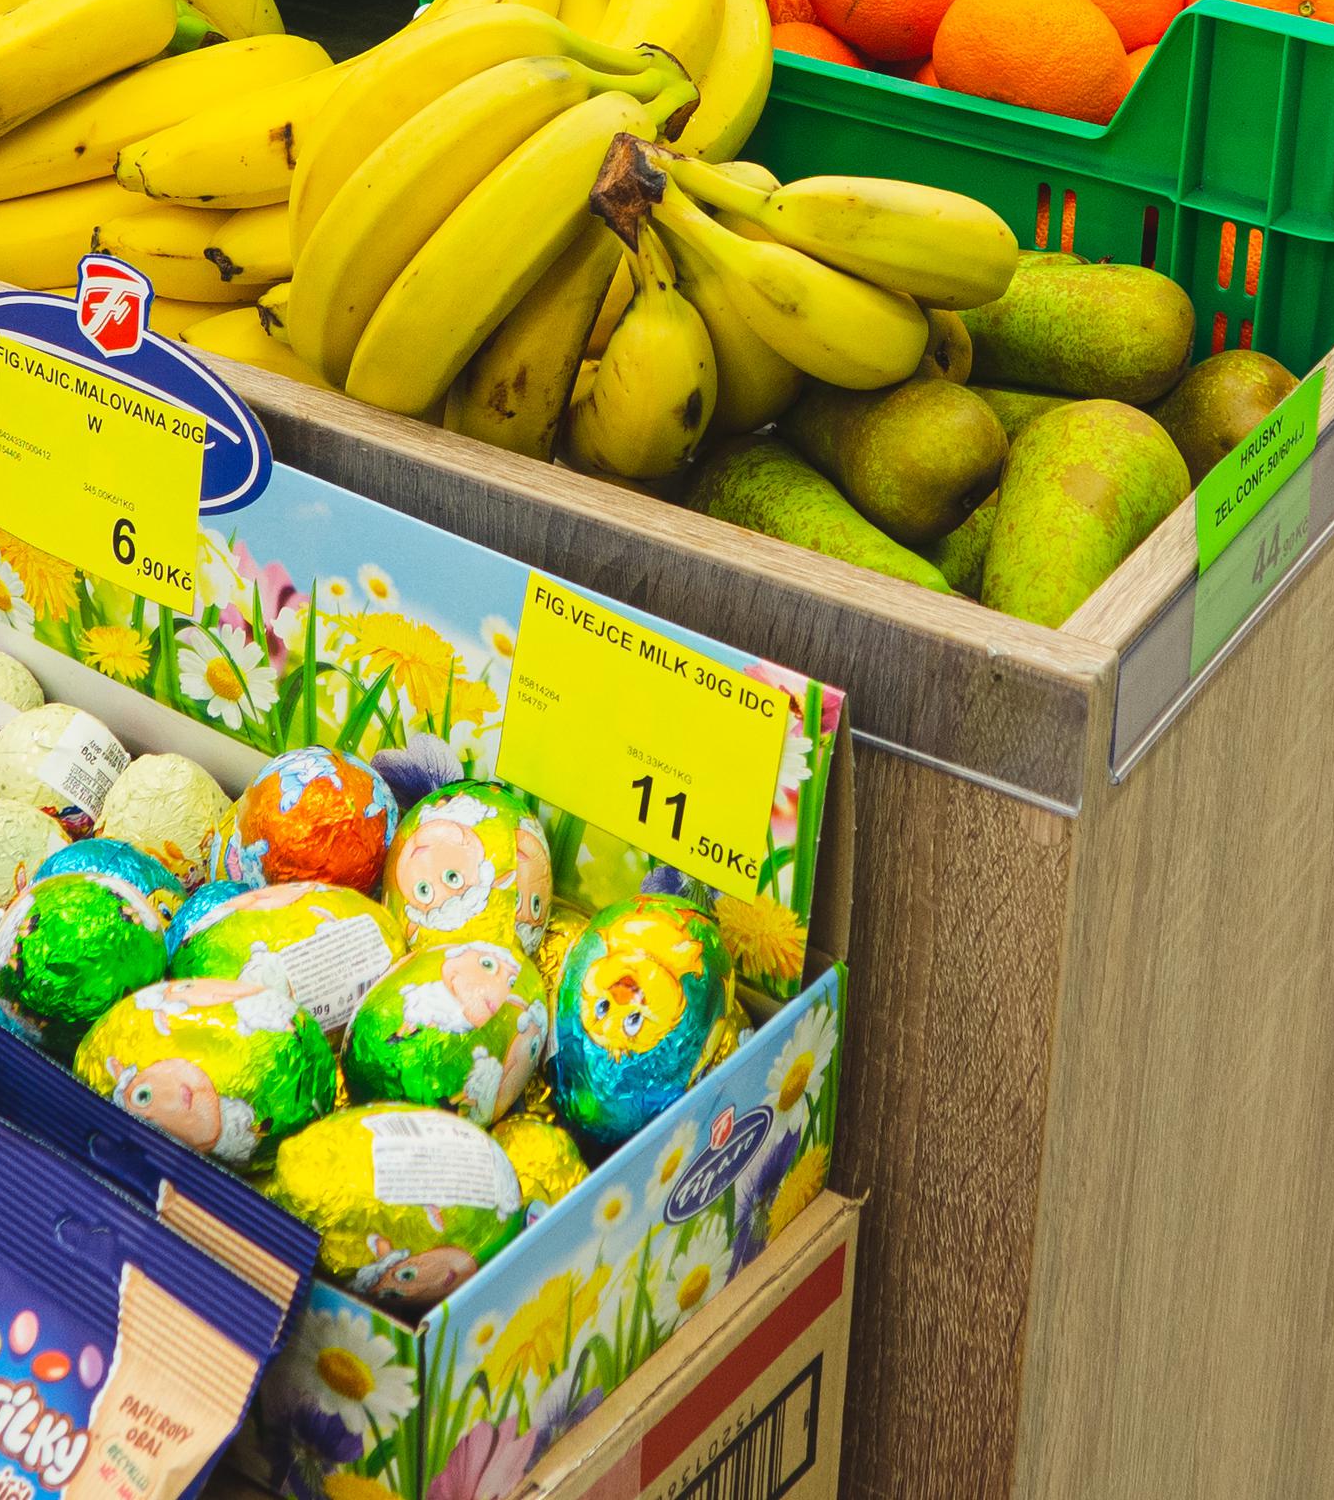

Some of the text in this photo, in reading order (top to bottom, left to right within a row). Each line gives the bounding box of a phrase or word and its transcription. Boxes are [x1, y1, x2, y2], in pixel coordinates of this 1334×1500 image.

[87, 414, 104, 435] W
[171, 417, 205, 446] 20G
[1239, 415, 1285, 470] HRUSKY
[534, 586, 776, 719] FIG.VEJCE MILK 30G IDC
[125, 1426, 164, 1458] OBAL
